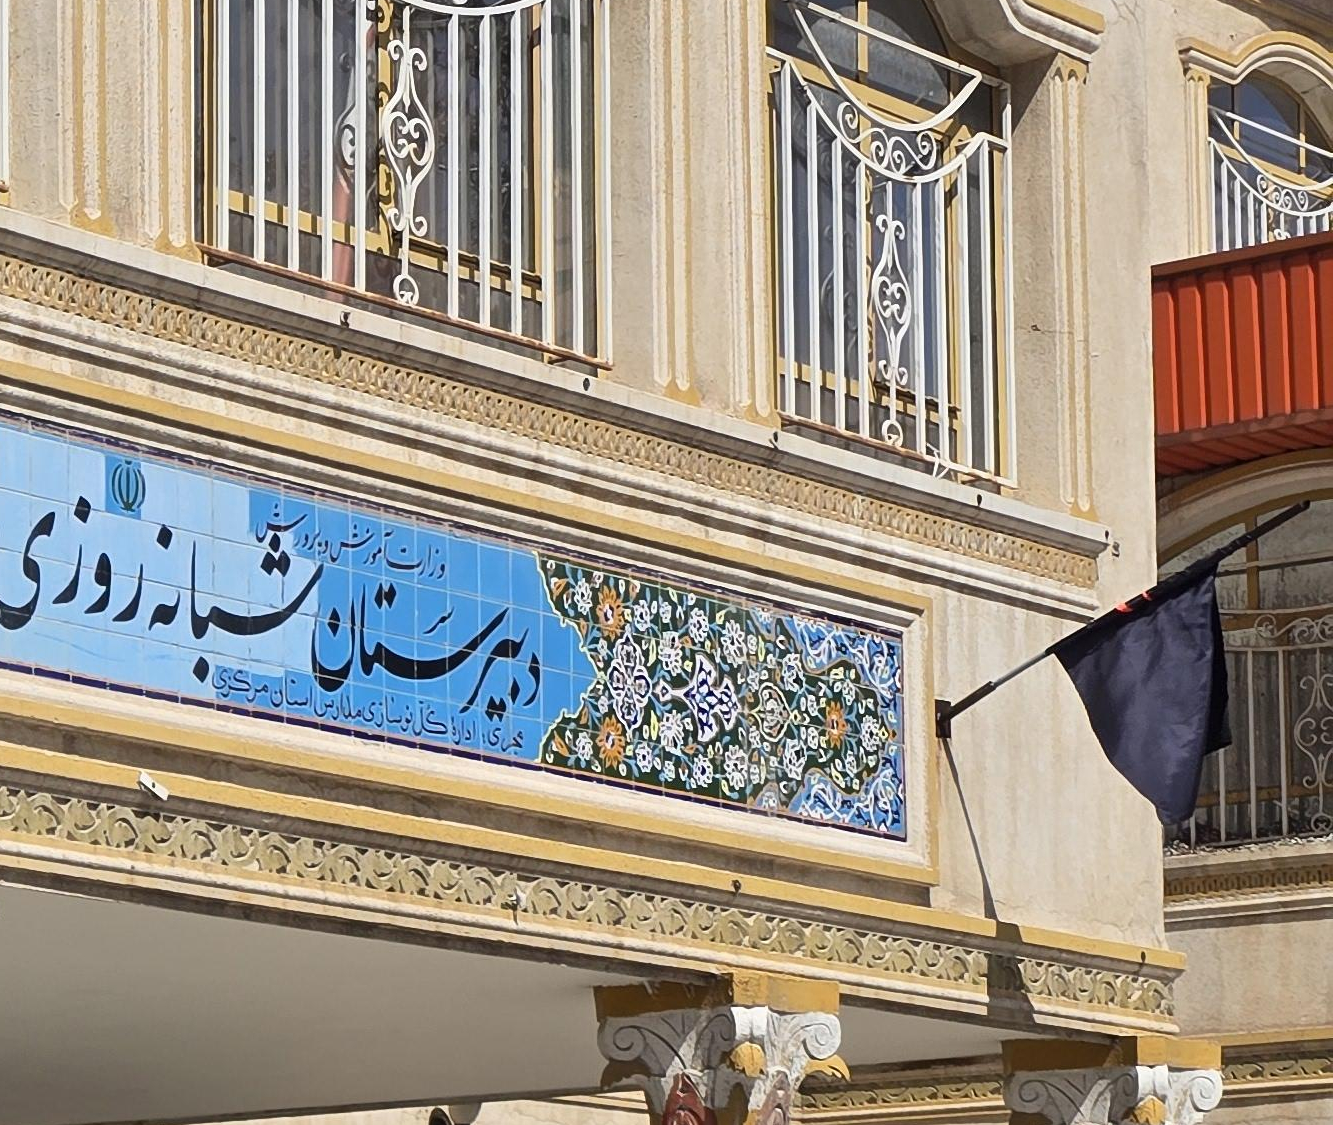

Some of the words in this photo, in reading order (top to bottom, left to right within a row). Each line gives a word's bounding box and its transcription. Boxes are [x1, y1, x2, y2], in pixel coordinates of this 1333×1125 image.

[255, 502, 323, 556] پرورش
[330, 523, 395, 565] آموزش
[385, 544, 446, 580] وزارت
[310, 581, 542, 720] دبیرستان
[211, 666, 269, 703] مرکزی
[270, 678, 313, 708] استان
[314, 692, 362, 721] مدارس
